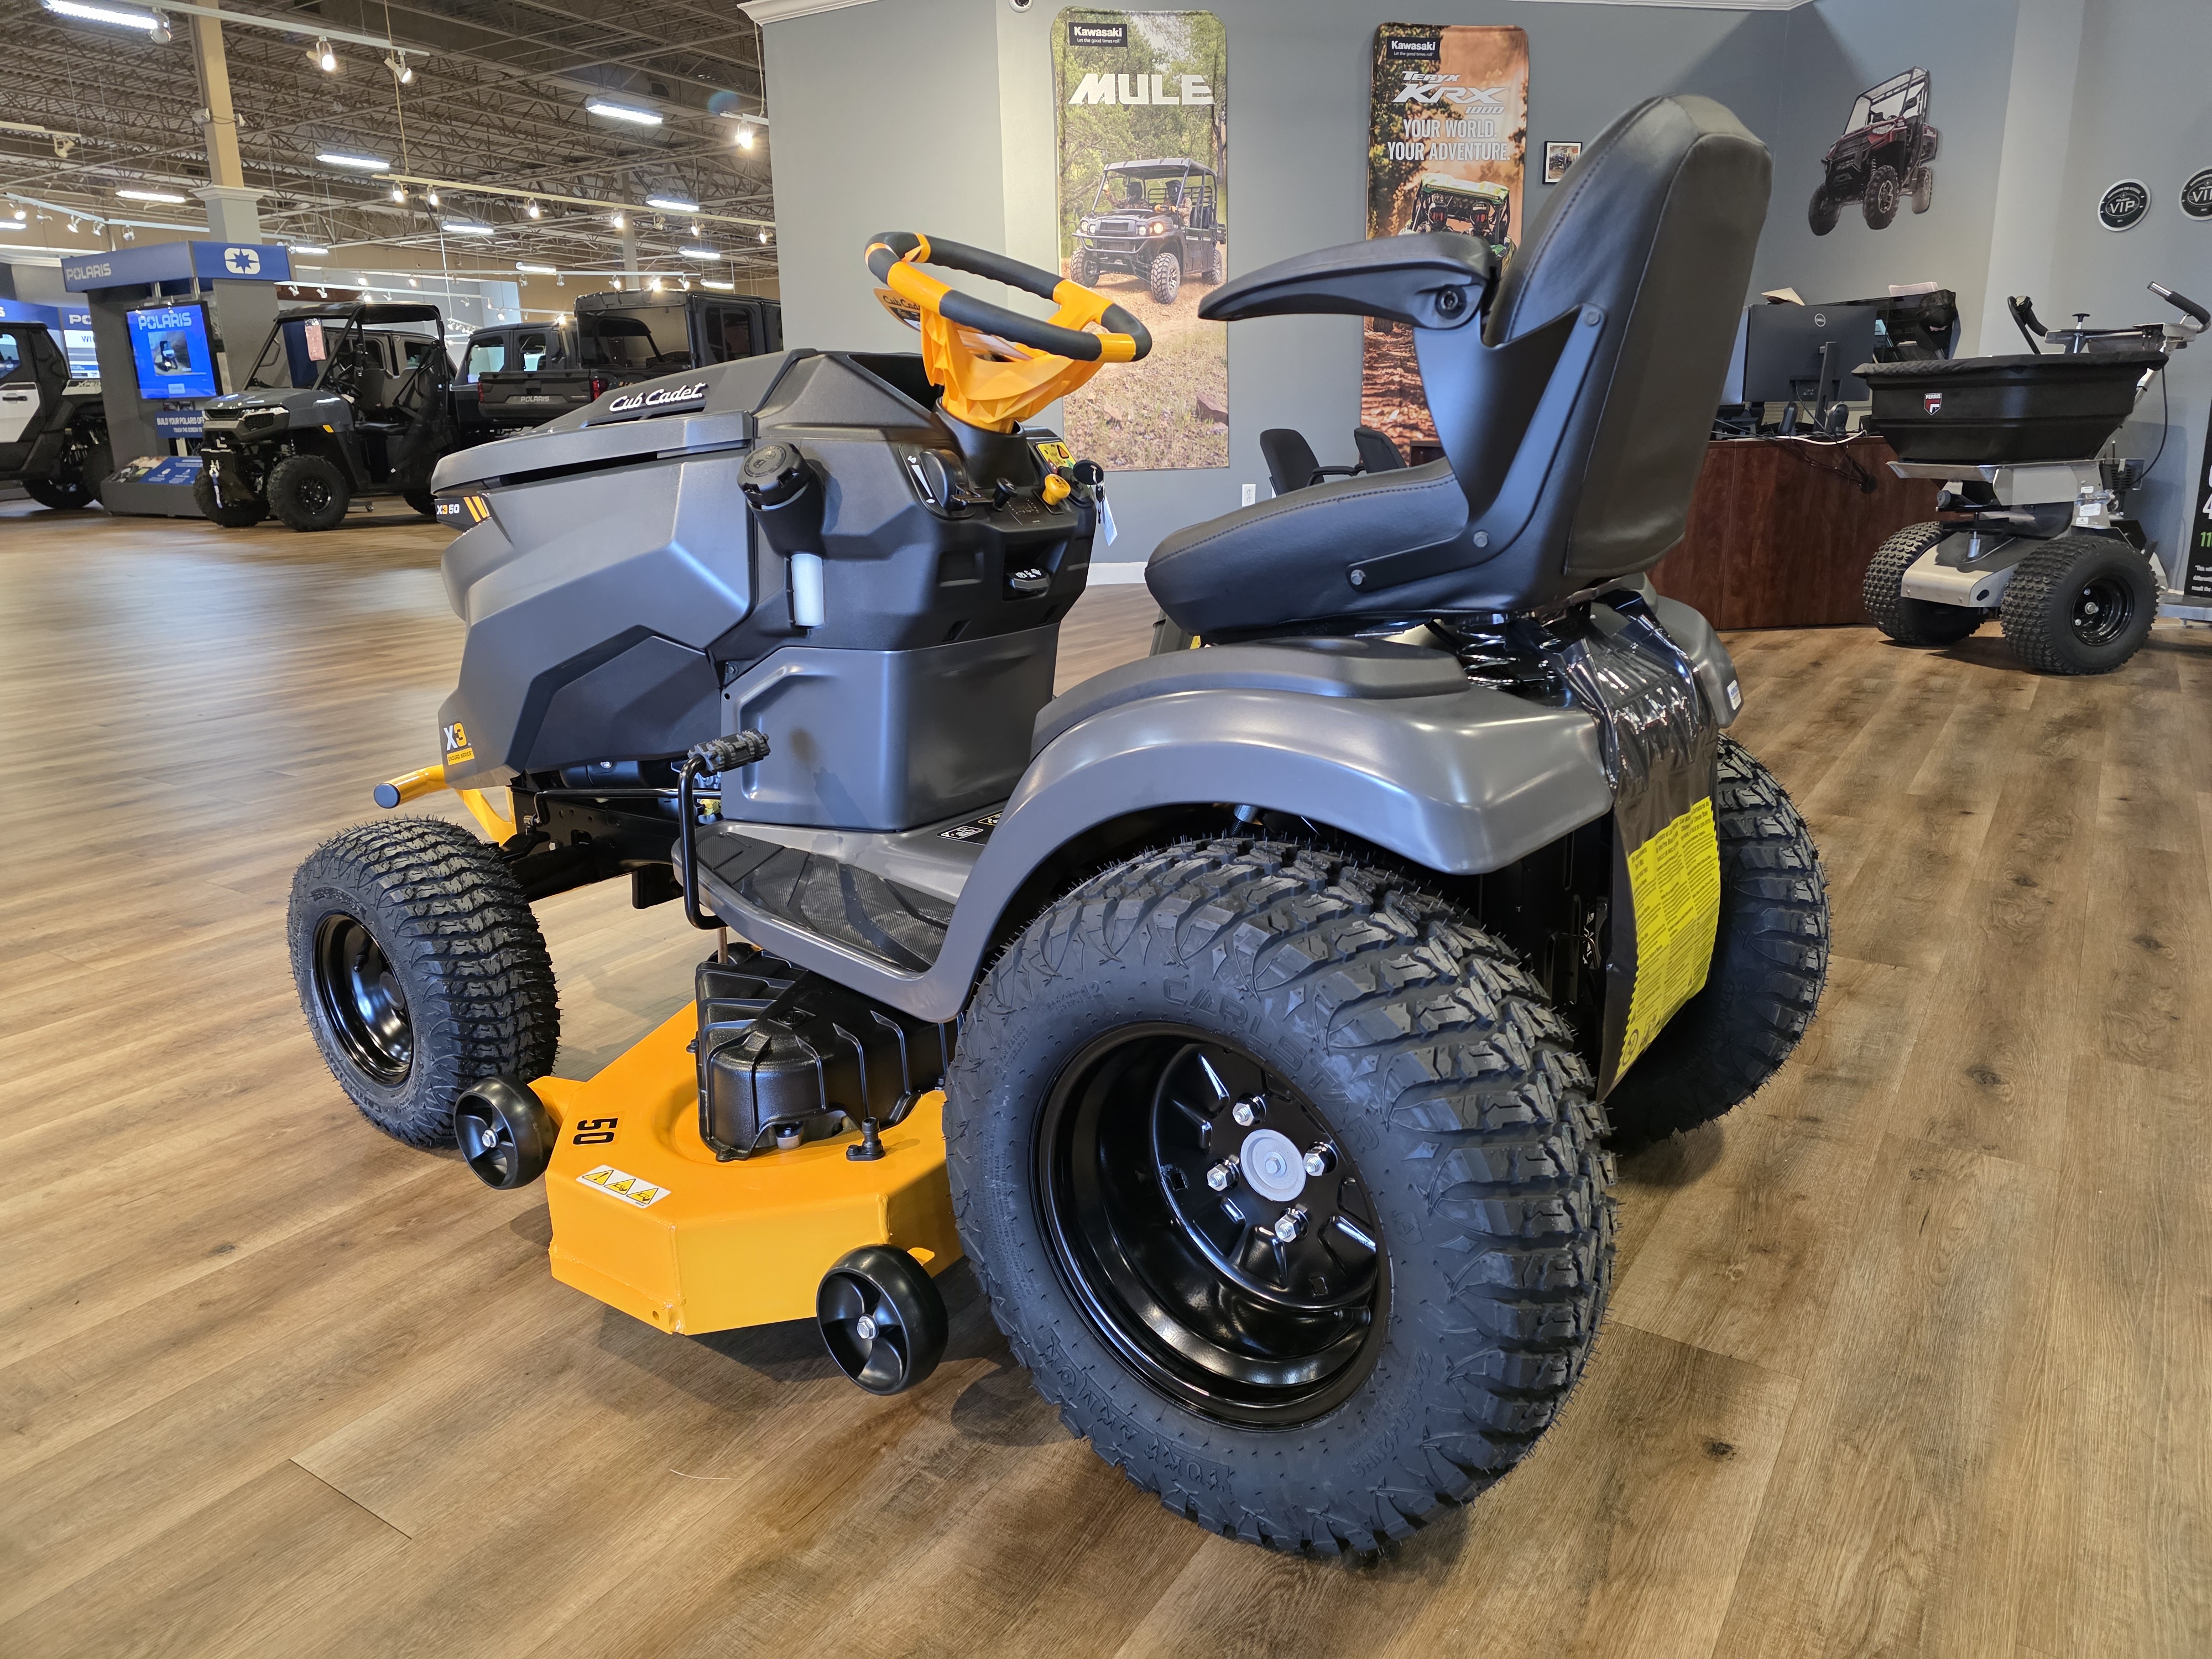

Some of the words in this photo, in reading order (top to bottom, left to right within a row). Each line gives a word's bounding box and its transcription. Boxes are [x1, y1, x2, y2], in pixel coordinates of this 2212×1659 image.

[1074, 26, 1122, 37] Kawasaki
[1391, 40, 1436, 51] Kawasaki
[1402, 71, 1461, 83] TERYX
[1068, 73, 1216, 105] MULE
[1392, 84, 1507, 104] KRX
[1465, 106, 1505, 114] 1000
[1403, 119, 1441, 138] YOUR
[1445, 119, 1498, 138] WORLD.
[1387, 142, 1425, 161] YOUR
[1428, 142, 1511, 161] ADVENTURE.
[2110, 200, 2136, 214] VIP
[66, 263, 112, 281] POLARIS
[138, 312, 192, 331] POLARIS
[609, 392, 645, 412] Cub
[645, 382, 706, 405] Cadet
[156, 417, 169, 425] BUILD
[169, 417, 179, 425] YOUR
[179, 416, 197, 425] POLARIS
[444, 722, 467, 751] X3
[1163, 977, 1380, 1154] CARLSTAR
[572, 1118, 618, 1145] 50
